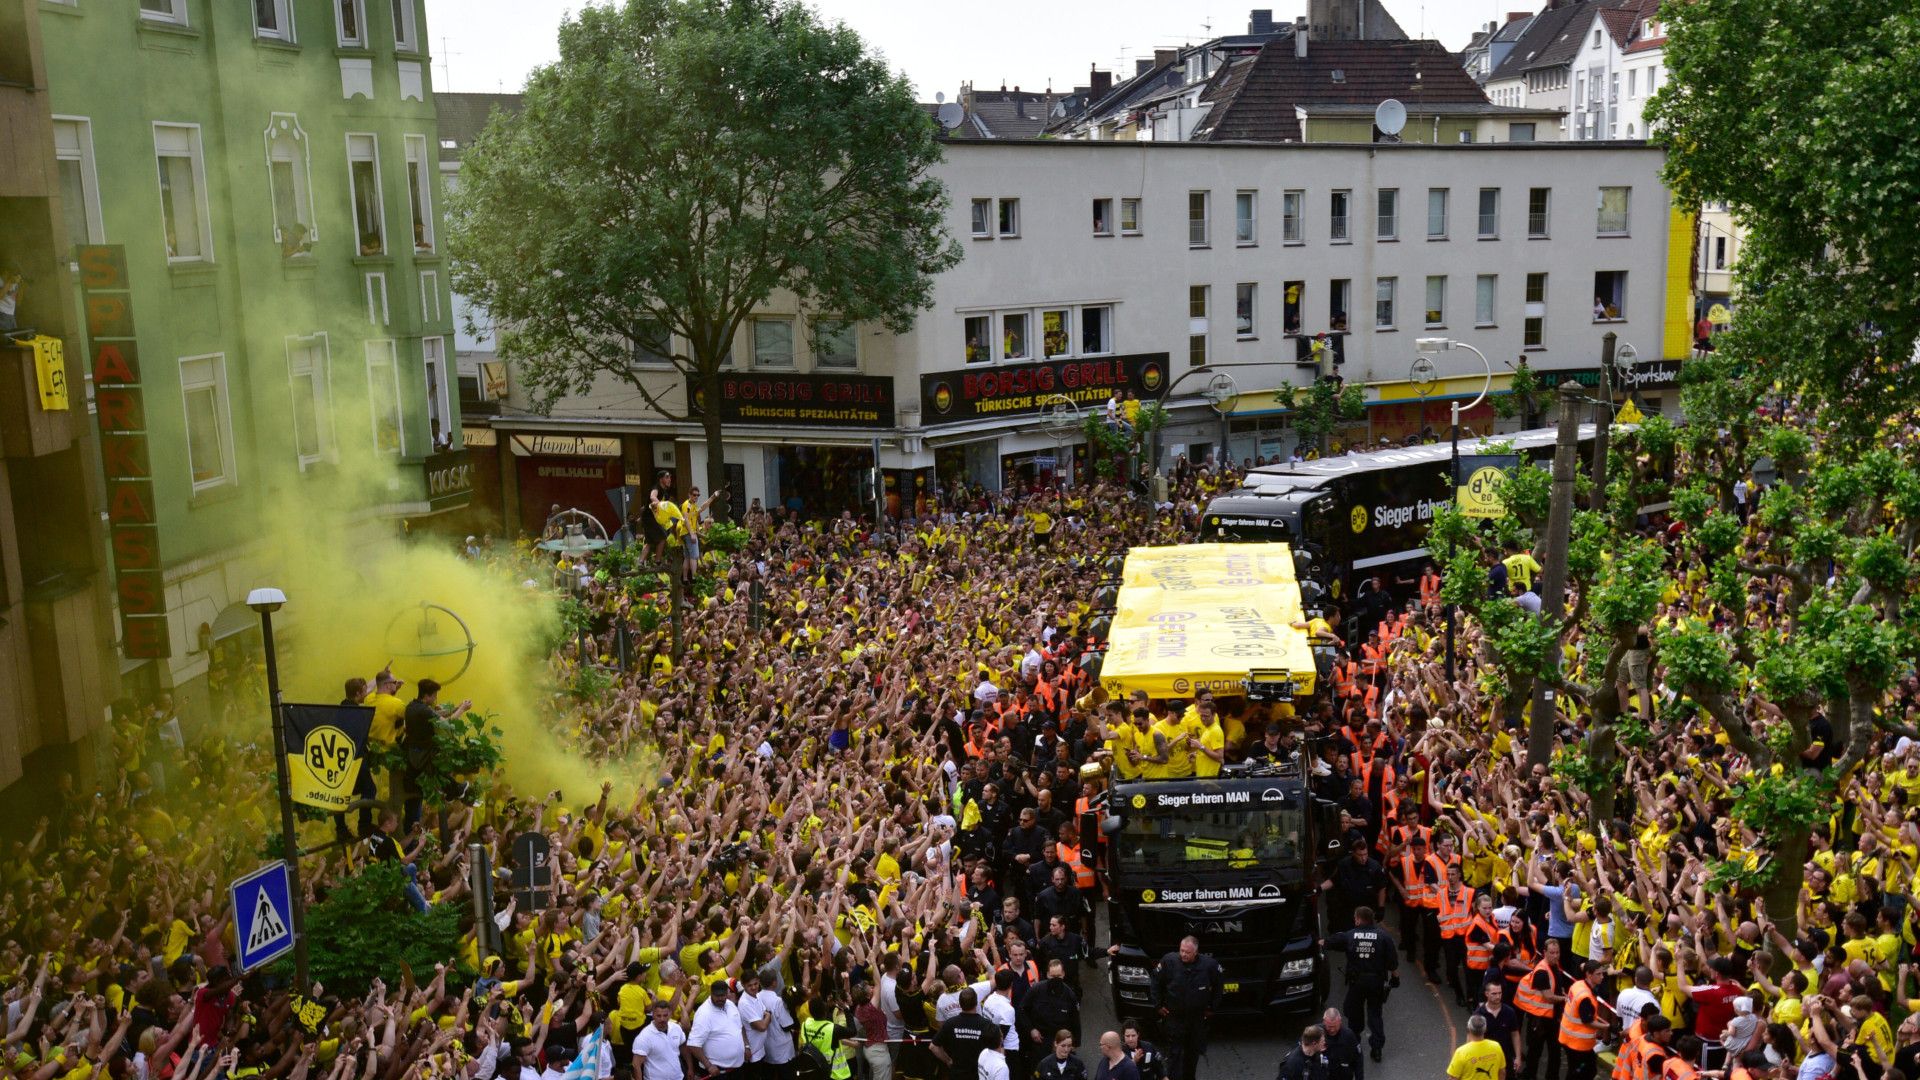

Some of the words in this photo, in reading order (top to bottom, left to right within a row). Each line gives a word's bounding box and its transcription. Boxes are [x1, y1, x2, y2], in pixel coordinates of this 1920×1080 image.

[963, 366, 1055, 399] BORSIG
[1062, 360, 1128, 388] GRILL
[1626, 363, 1677, 389] Sportsbar
[724, 380, 813, 401] BORSIG
[821, 383, 887, 403] GRILL
[975, 396, 1032, 413] TÜRKISCHE
[1035, 387, 1112, 407] SPEZIALITÄTEN
[739, 405, 796, 418] TÜRKISCHE
[799, 408, 878, 421] SPEZIALITÄTEN
[79, 248, 161, 657] SPARKASSE
[429, 465, 471, 495] KIOSK
[538, 466, 604, 479] SPIELHALLE
[1221, 518, 1237, 526] Sieger
[1238, 518, 1255, 526] fahren
[1256, 519, 1269, 527] MAN
[1374, 505, 1415, 529] Sieger
[1158, 794, 1189, 808] Sieger
[1191, 793, 1224, 804] fahren
[1226, 791, 1250, 803] MAN
[1161, 889, 1192, 902] Sieger
[1195, 888, 1227, 900] fahren
[1229, 887, 1253, 898] MAN
[1353, 932, 1378, 940] POLIZEI
